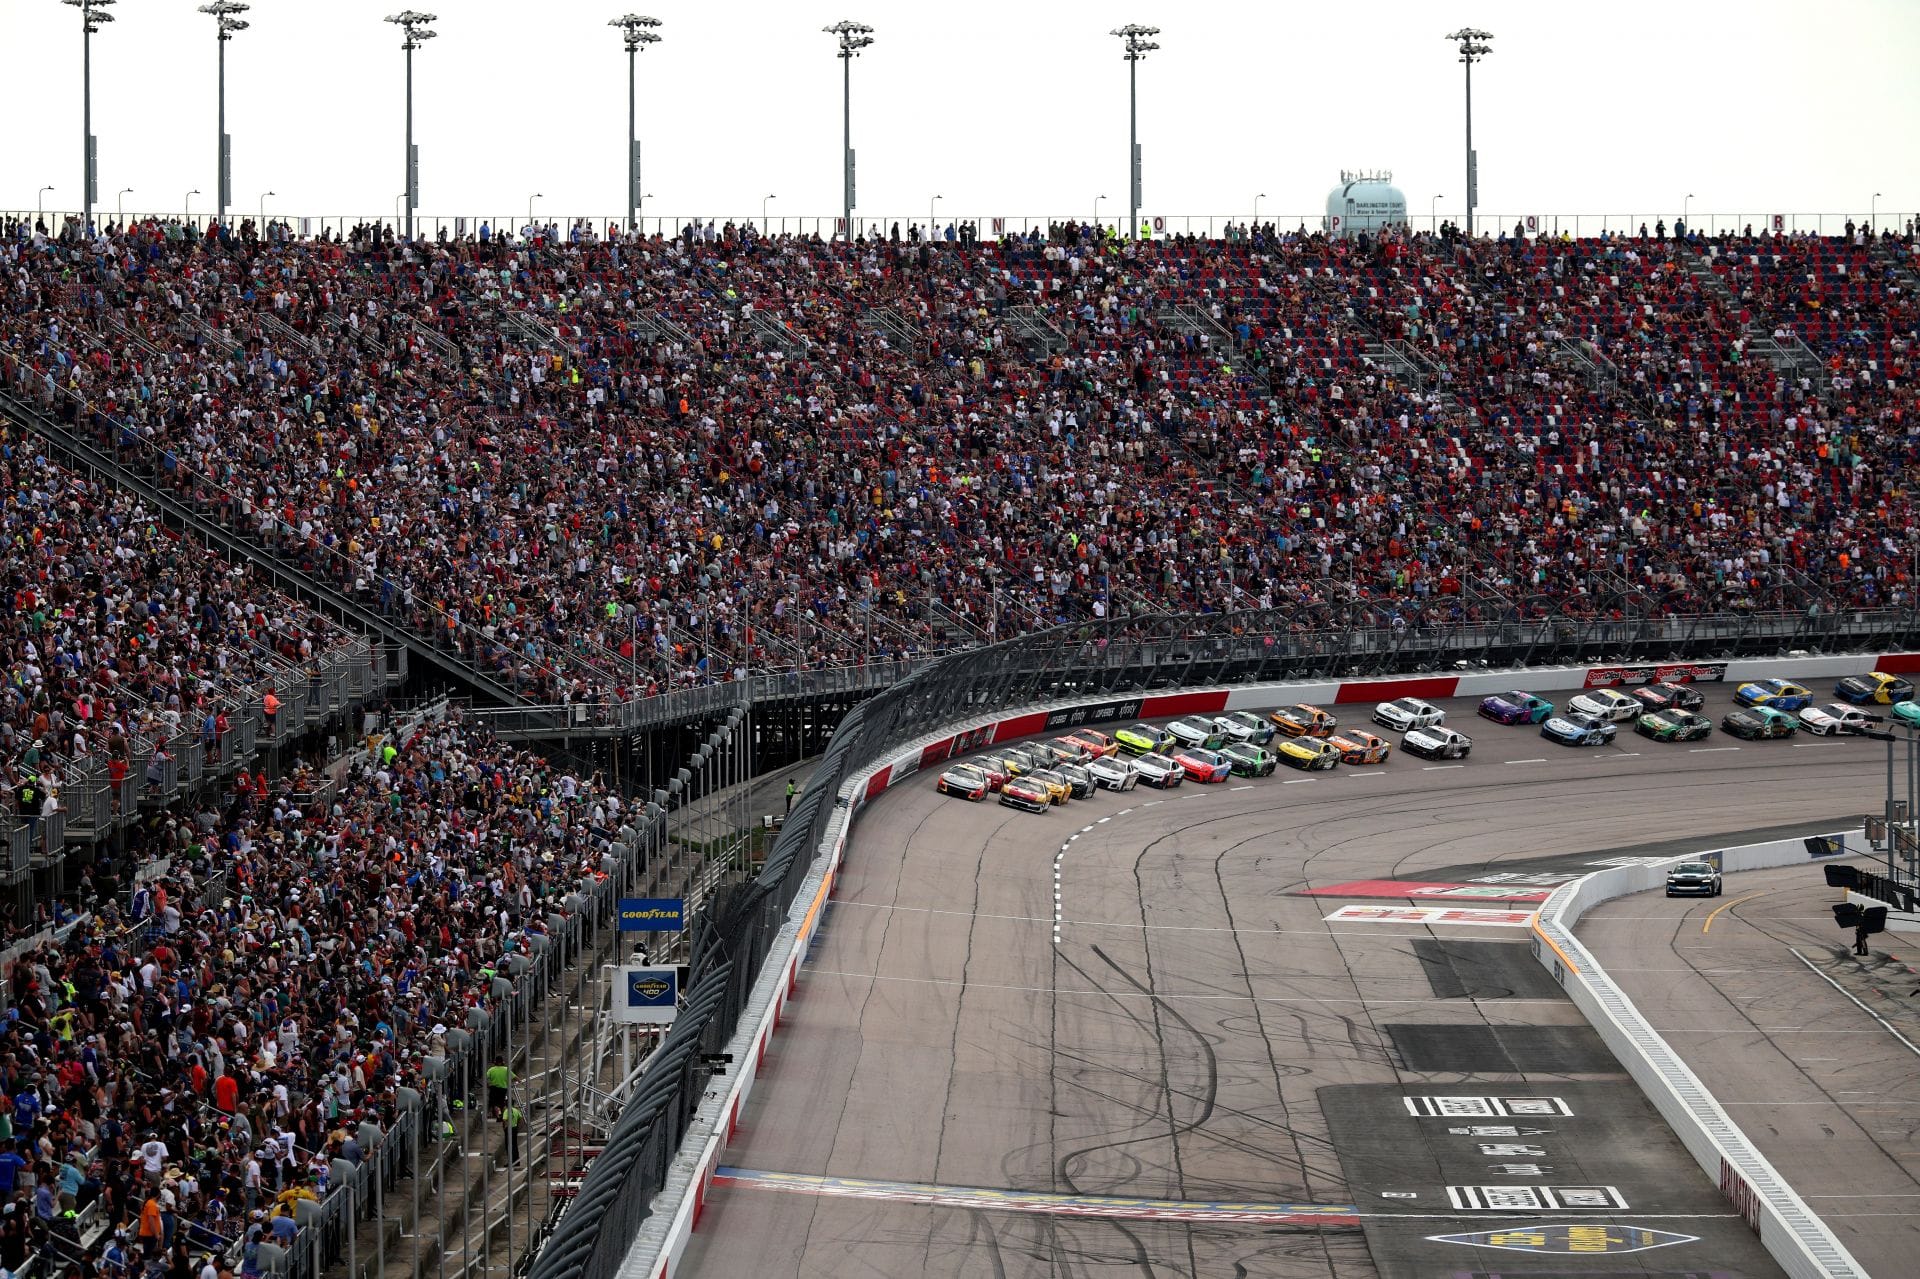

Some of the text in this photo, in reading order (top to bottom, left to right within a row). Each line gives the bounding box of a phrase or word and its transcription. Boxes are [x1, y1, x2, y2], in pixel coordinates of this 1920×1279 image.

[838, 217, 845, 232] M
[993, 217, 1002, 232] N
[1154, 217, 1163, 231] O
[1332, 217, 1340, 231] P
[1528, 216, 1536, 230] Q
[1774, 215, 1783, 229] R
[1764, 725, 1772, 735] 3
[622, 909, 679, 919] GOODYEAR
